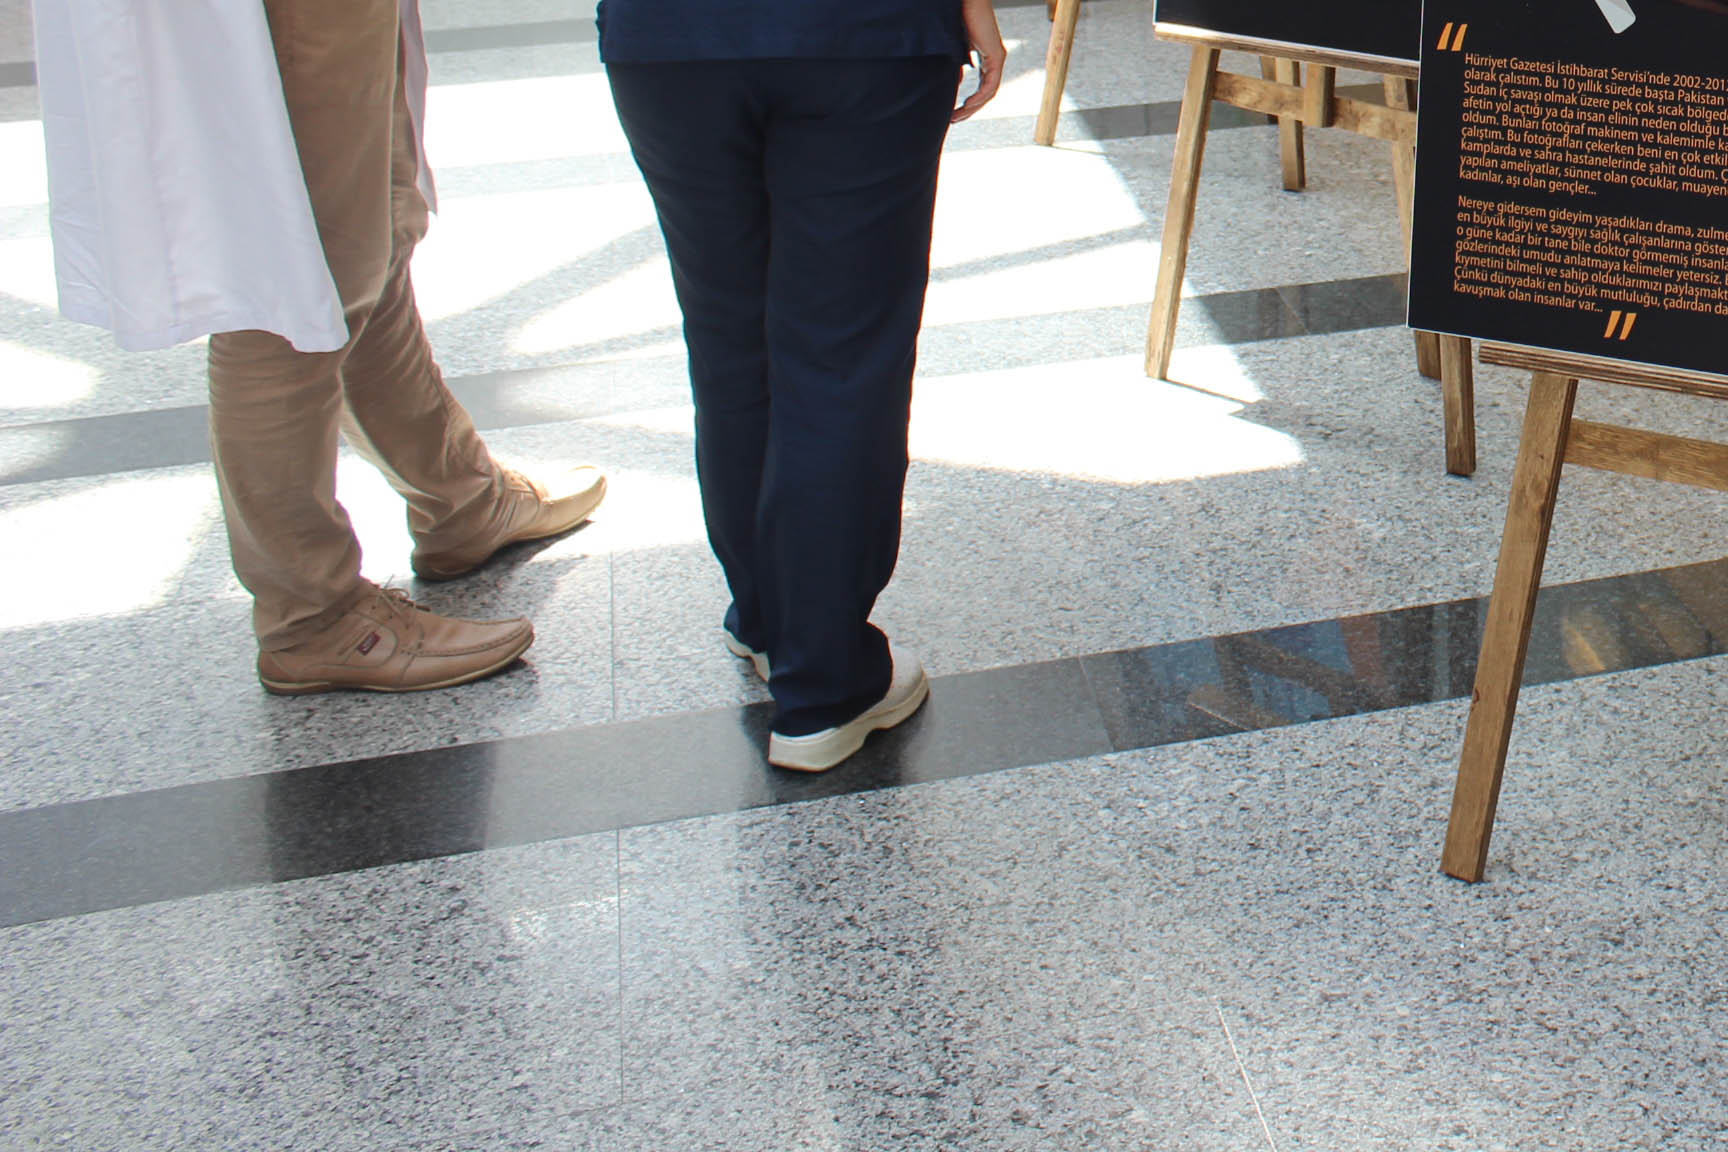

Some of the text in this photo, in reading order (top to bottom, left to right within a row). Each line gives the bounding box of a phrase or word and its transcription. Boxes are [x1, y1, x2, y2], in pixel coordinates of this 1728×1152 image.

[1462, 110, 1499, 126] oldum.
[1501, 113, 1539, 130] Bunları
[1541, 117, 1586, 136] fotoğraf
[1587, 125, 1639, 141] makinem
[1641, 132, 1655, 143] ve
[1656, 131, 1716, 150] kalemimle
[1459, 154, 1498, 170] yapılan
[1500, 159, 1561, 177] ameliyatlar,
[1563, 166, 1602, 181] sünnet
[1603, 170, 1628, 184] olan
[1630, 175, 1679, 192] çocuklar,
[1455, 238, 1520, 257] gözlerindeki
[1522, 249, 1561, 263] umudu
[1563, 253, 1621, 273] anlatmaya
[1622, 259, 1674, 278] kelimeler
[1675, 270, 1722, 285] yetersiz.
